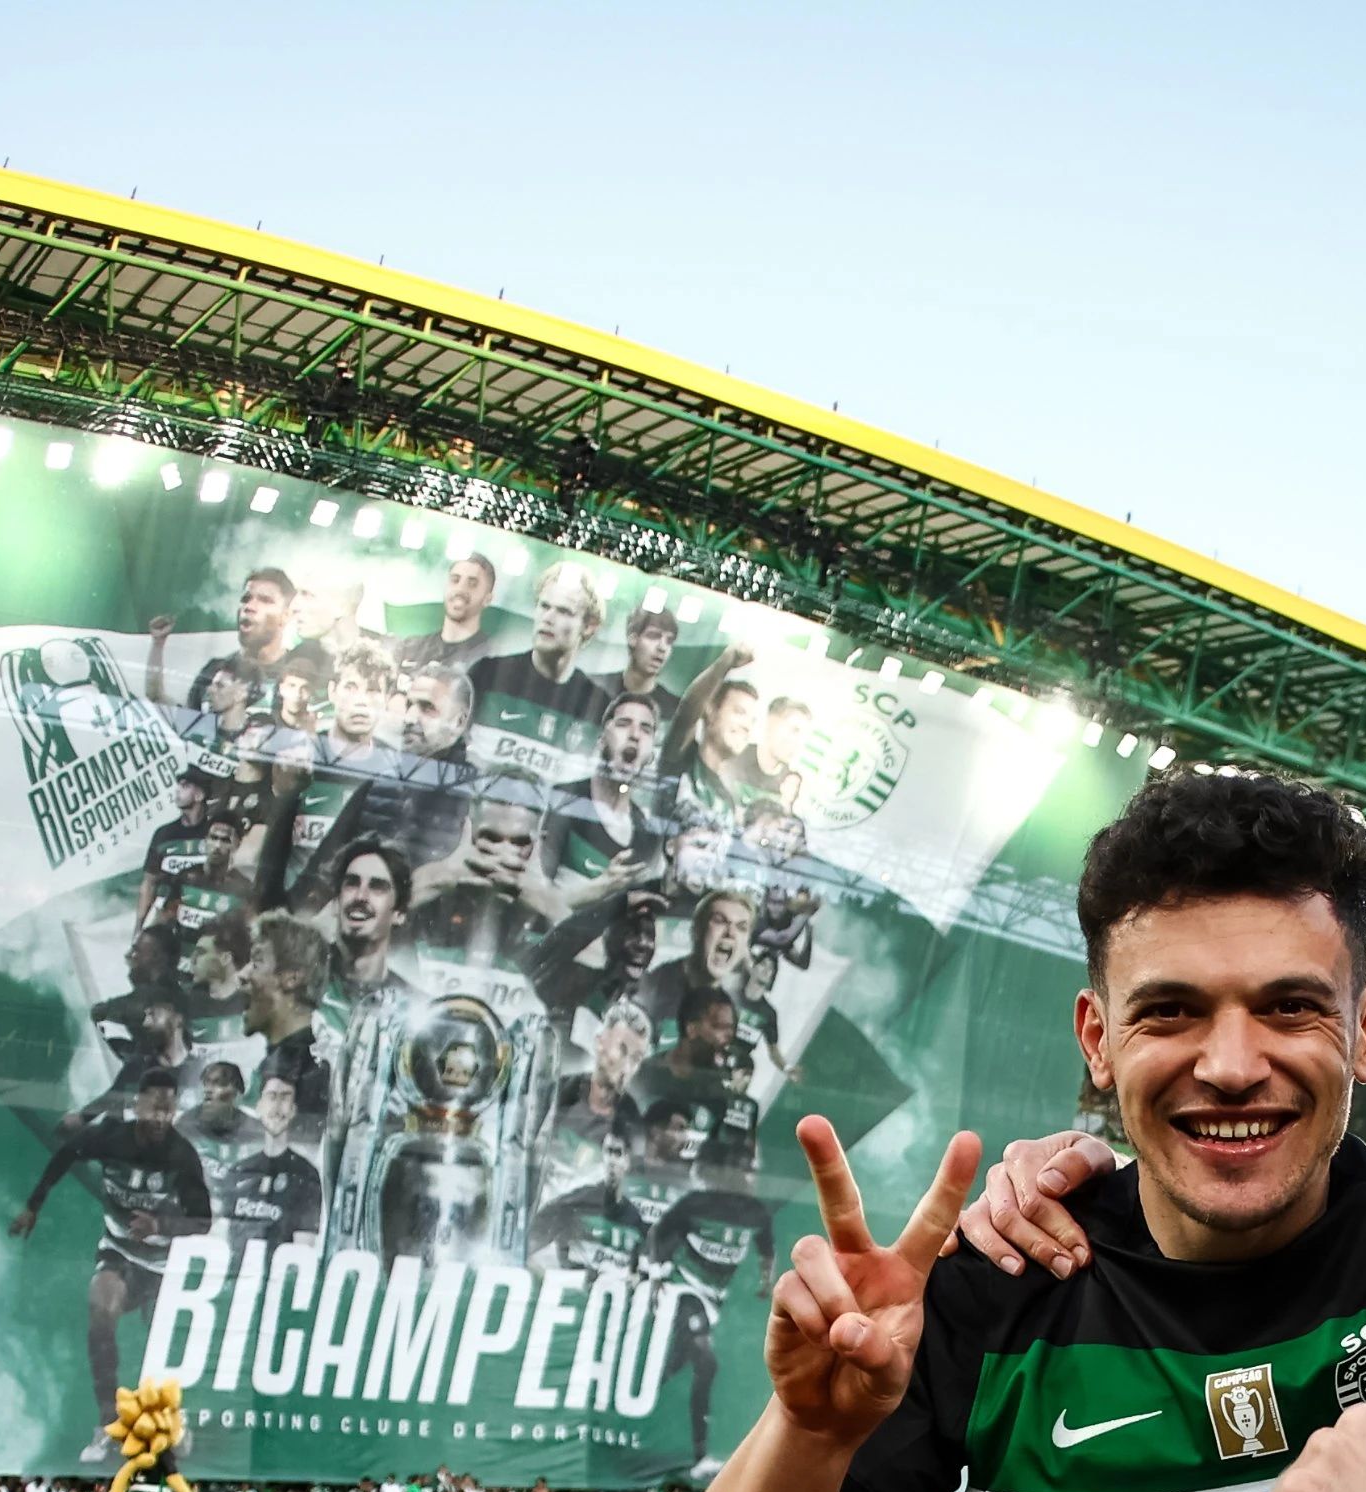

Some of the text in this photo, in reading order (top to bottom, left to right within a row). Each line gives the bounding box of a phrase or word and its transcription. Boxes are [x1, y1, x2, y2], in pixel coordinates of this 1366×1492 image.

[854, 683, 917, 729] SCP
[71, 755, 179, 850] SPORTING CP
[340, 1415, 432, 1438] CLUBE
[453, 1421, 486, 1439] DE
[511, 1422, 641, 1449] PORTUGAL
